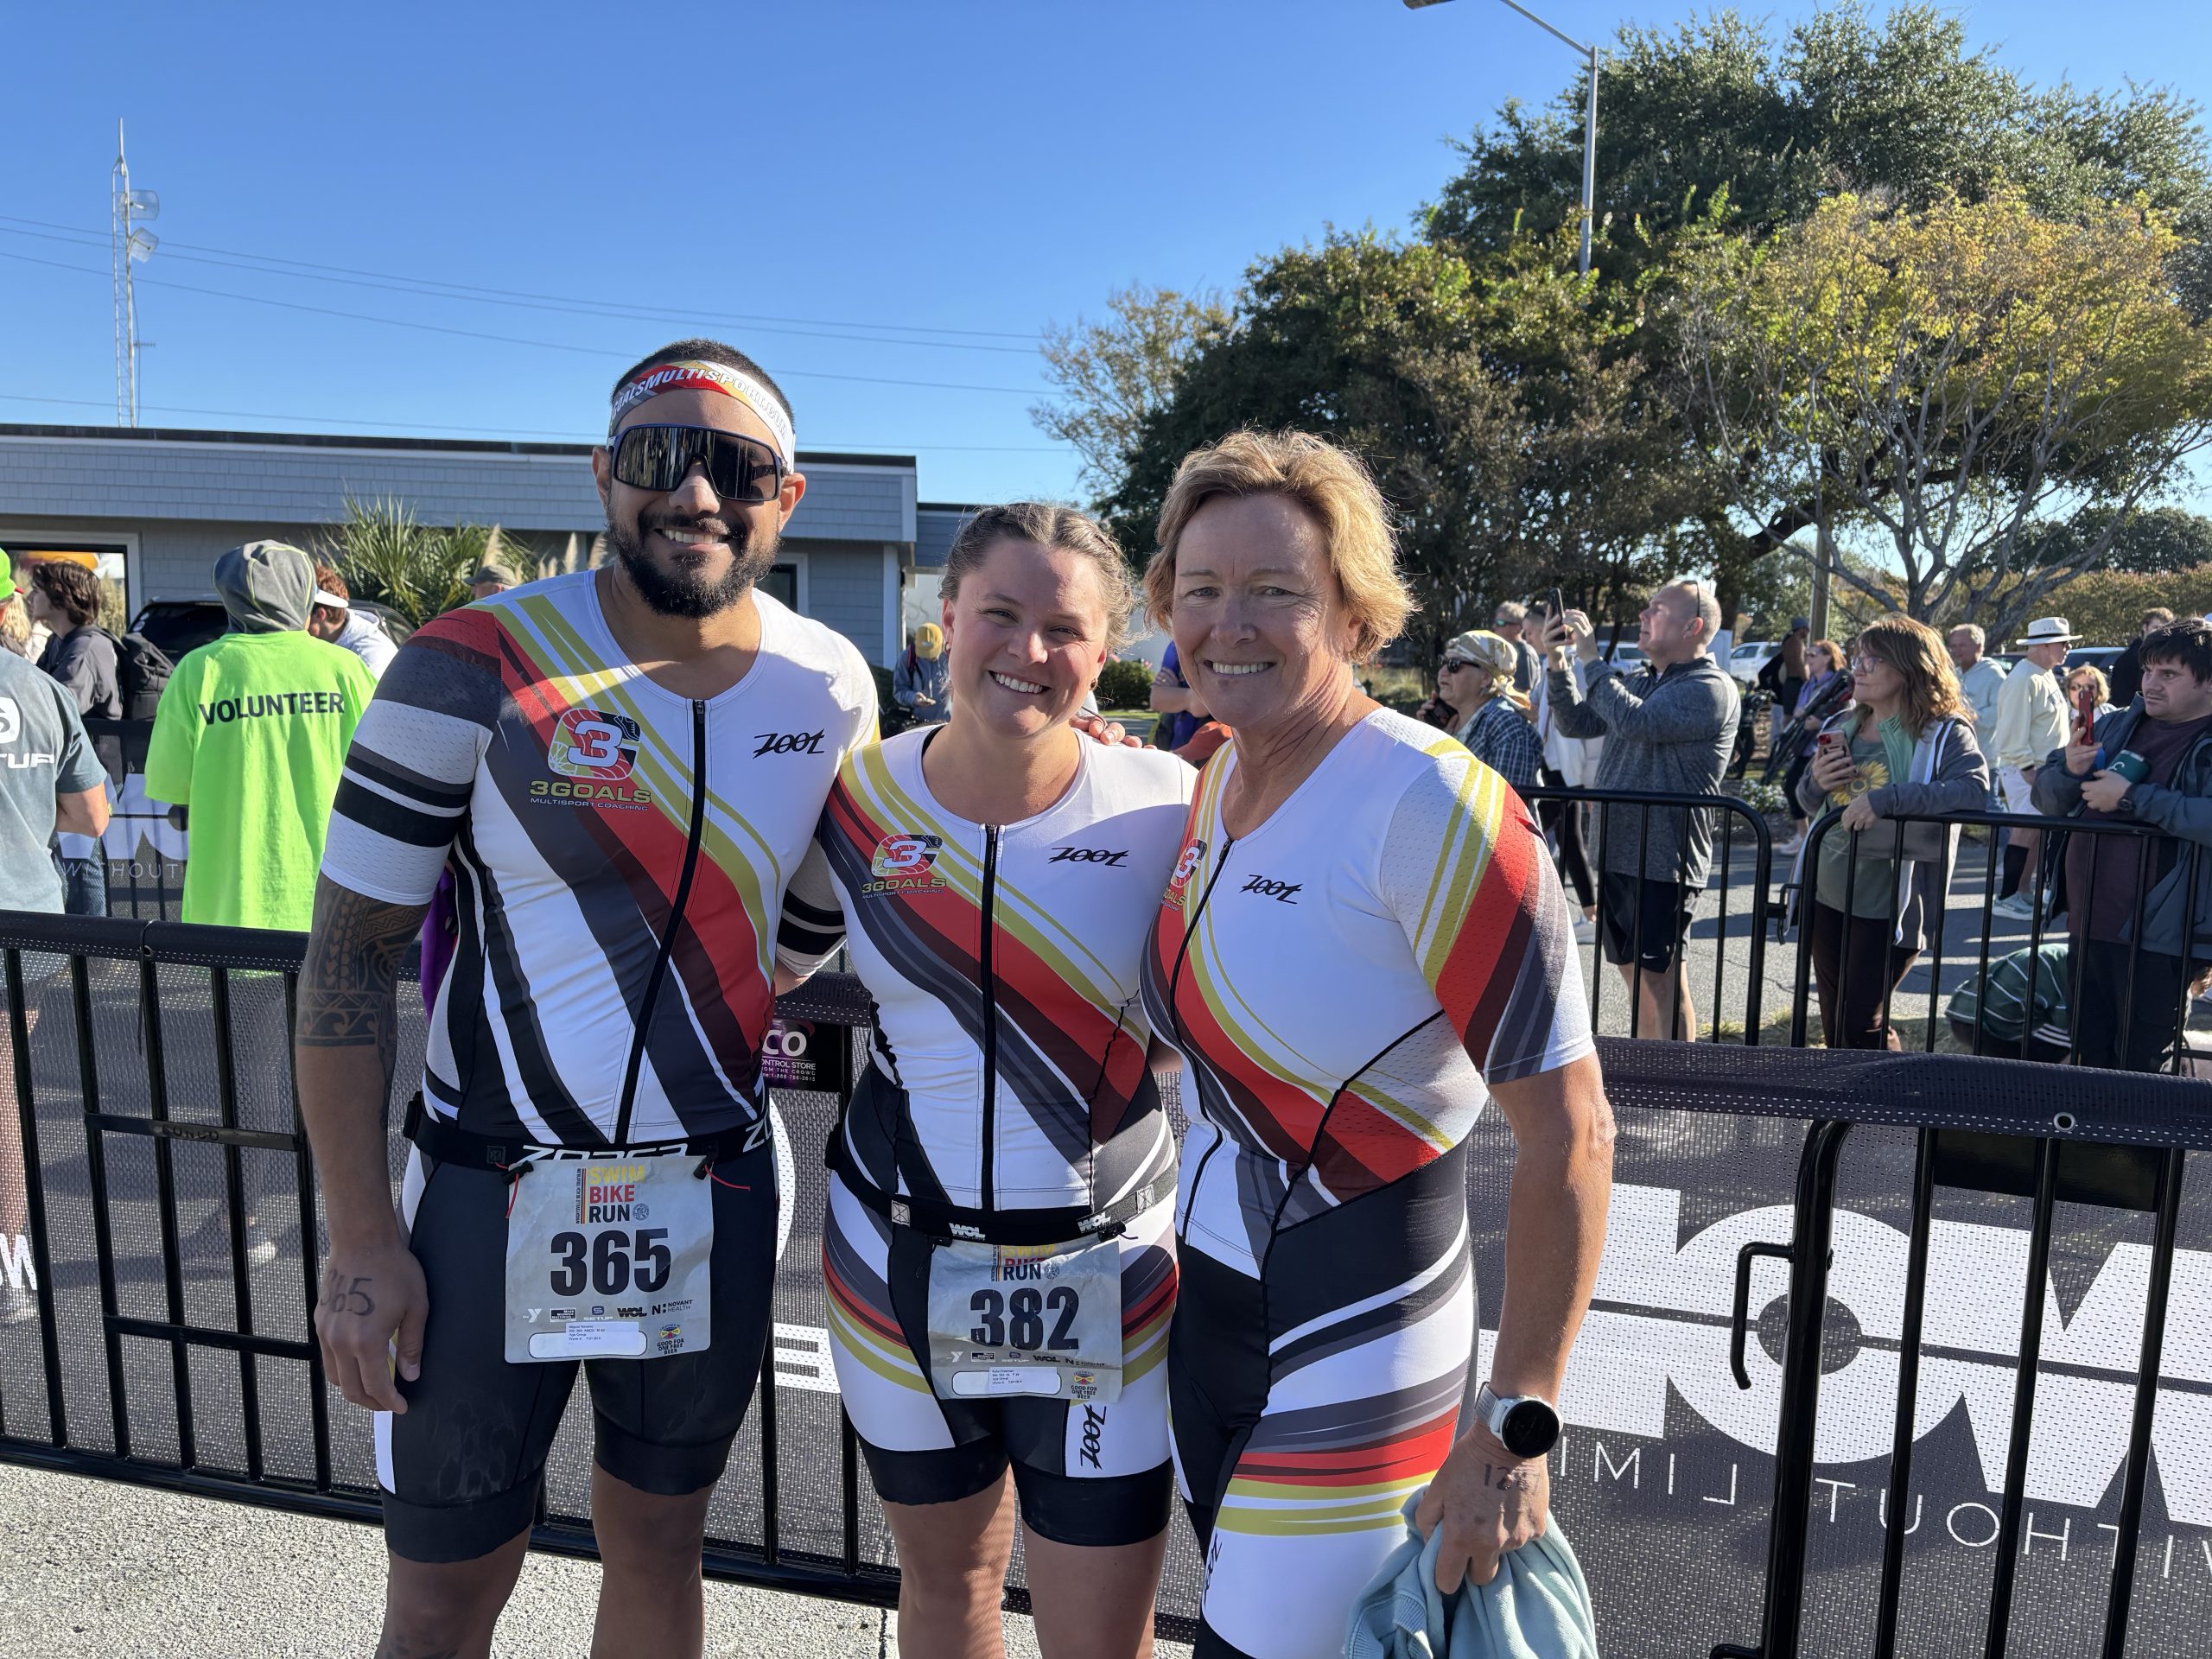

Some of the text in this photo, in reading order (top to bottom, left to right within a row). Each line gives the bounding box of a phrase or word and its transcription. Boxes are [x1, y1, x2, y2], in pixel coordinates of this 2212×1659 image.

[199, 692, 344, 725] VOLUNTEER
[567, 720, 623, 767] 3
[530, 779, 652, 804] 3GOALS
[530, 798, 648, 811] MULTISPORT COACHING
[861, 877, 947, 893] 3GOALS
[862, 890, 899, 899] MULTISPORT
[761, 1029, 807, 1057] CO
[791, 1061, 817, 1071] STORE
[589, 1164, 645, 1185] SWIM
[589, 1185, 635, 1204] BIKE
[588, 1205, 630, 1224] RUN
[550, 1228, 671, 1297] 365
[1003, 1262, 1041, 1281] RUN
[617, 1306, 647, 1318] WOL
[668, 1299, 693, 1308] NOVANT
[970, 1286, 1079, 1351] 382
